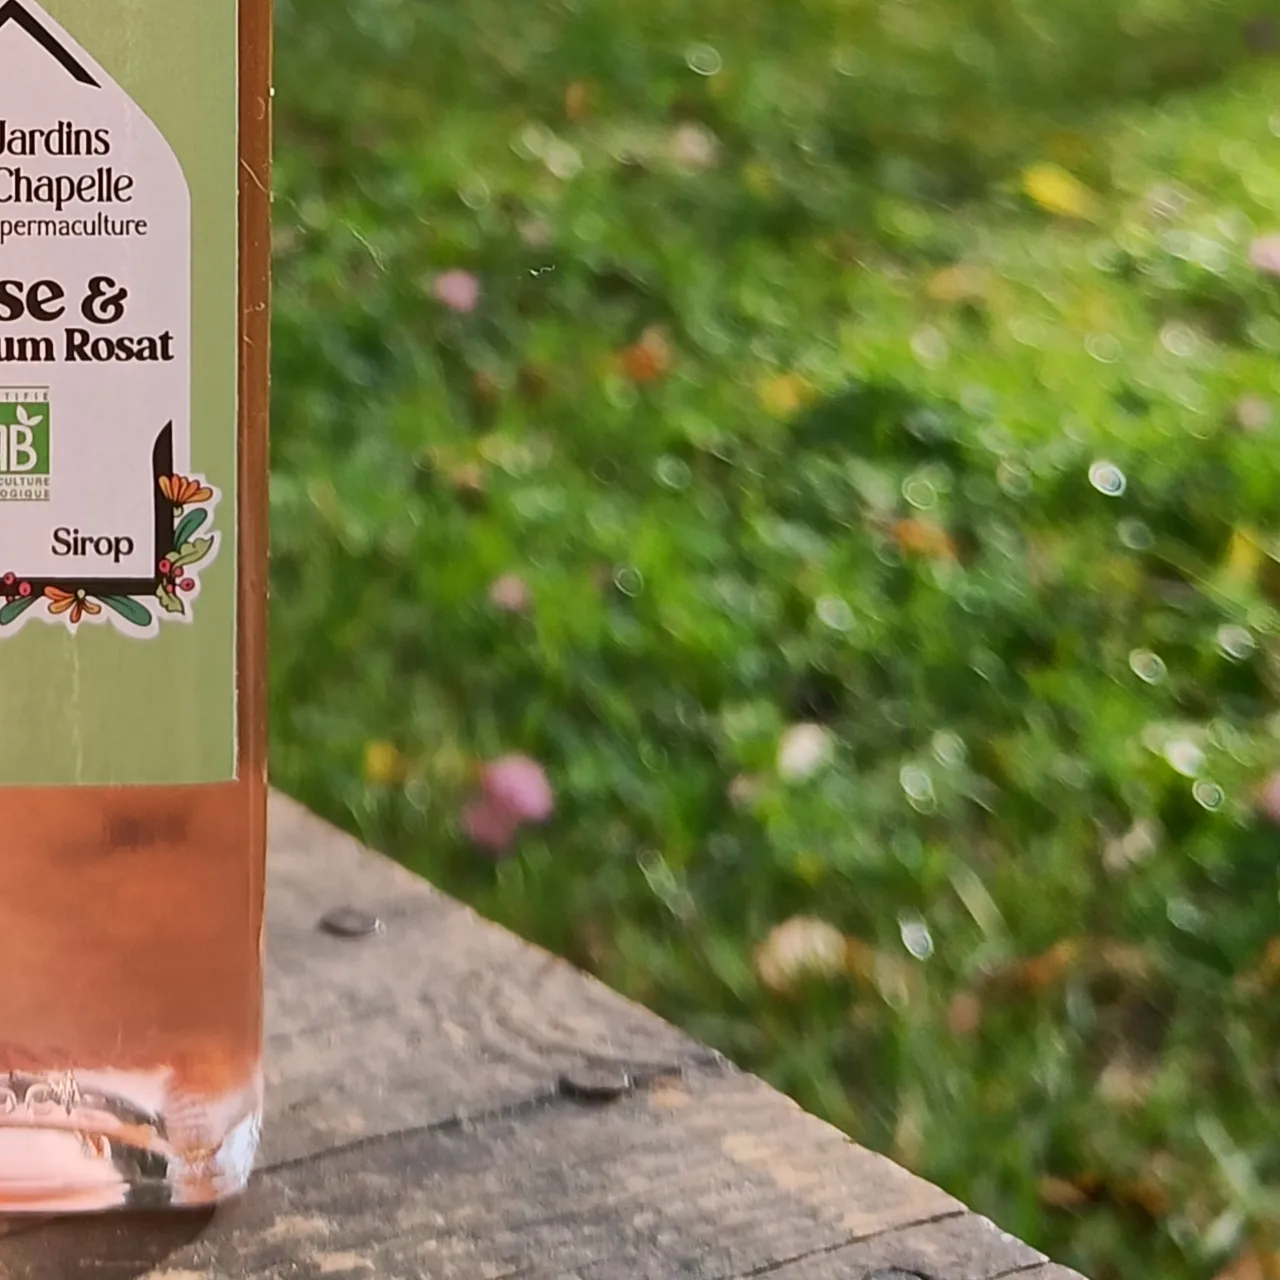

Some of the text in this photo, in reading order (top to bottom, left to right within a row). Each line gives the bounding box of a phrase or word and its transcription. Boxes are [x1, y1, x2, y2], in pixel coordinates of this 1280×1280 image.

[0, 211, 148, 245] permaculture
[80, 275, 128, 324] &
[64, 327, 175, 362] Rosat
[51, 527, 134, 564] Sirop
